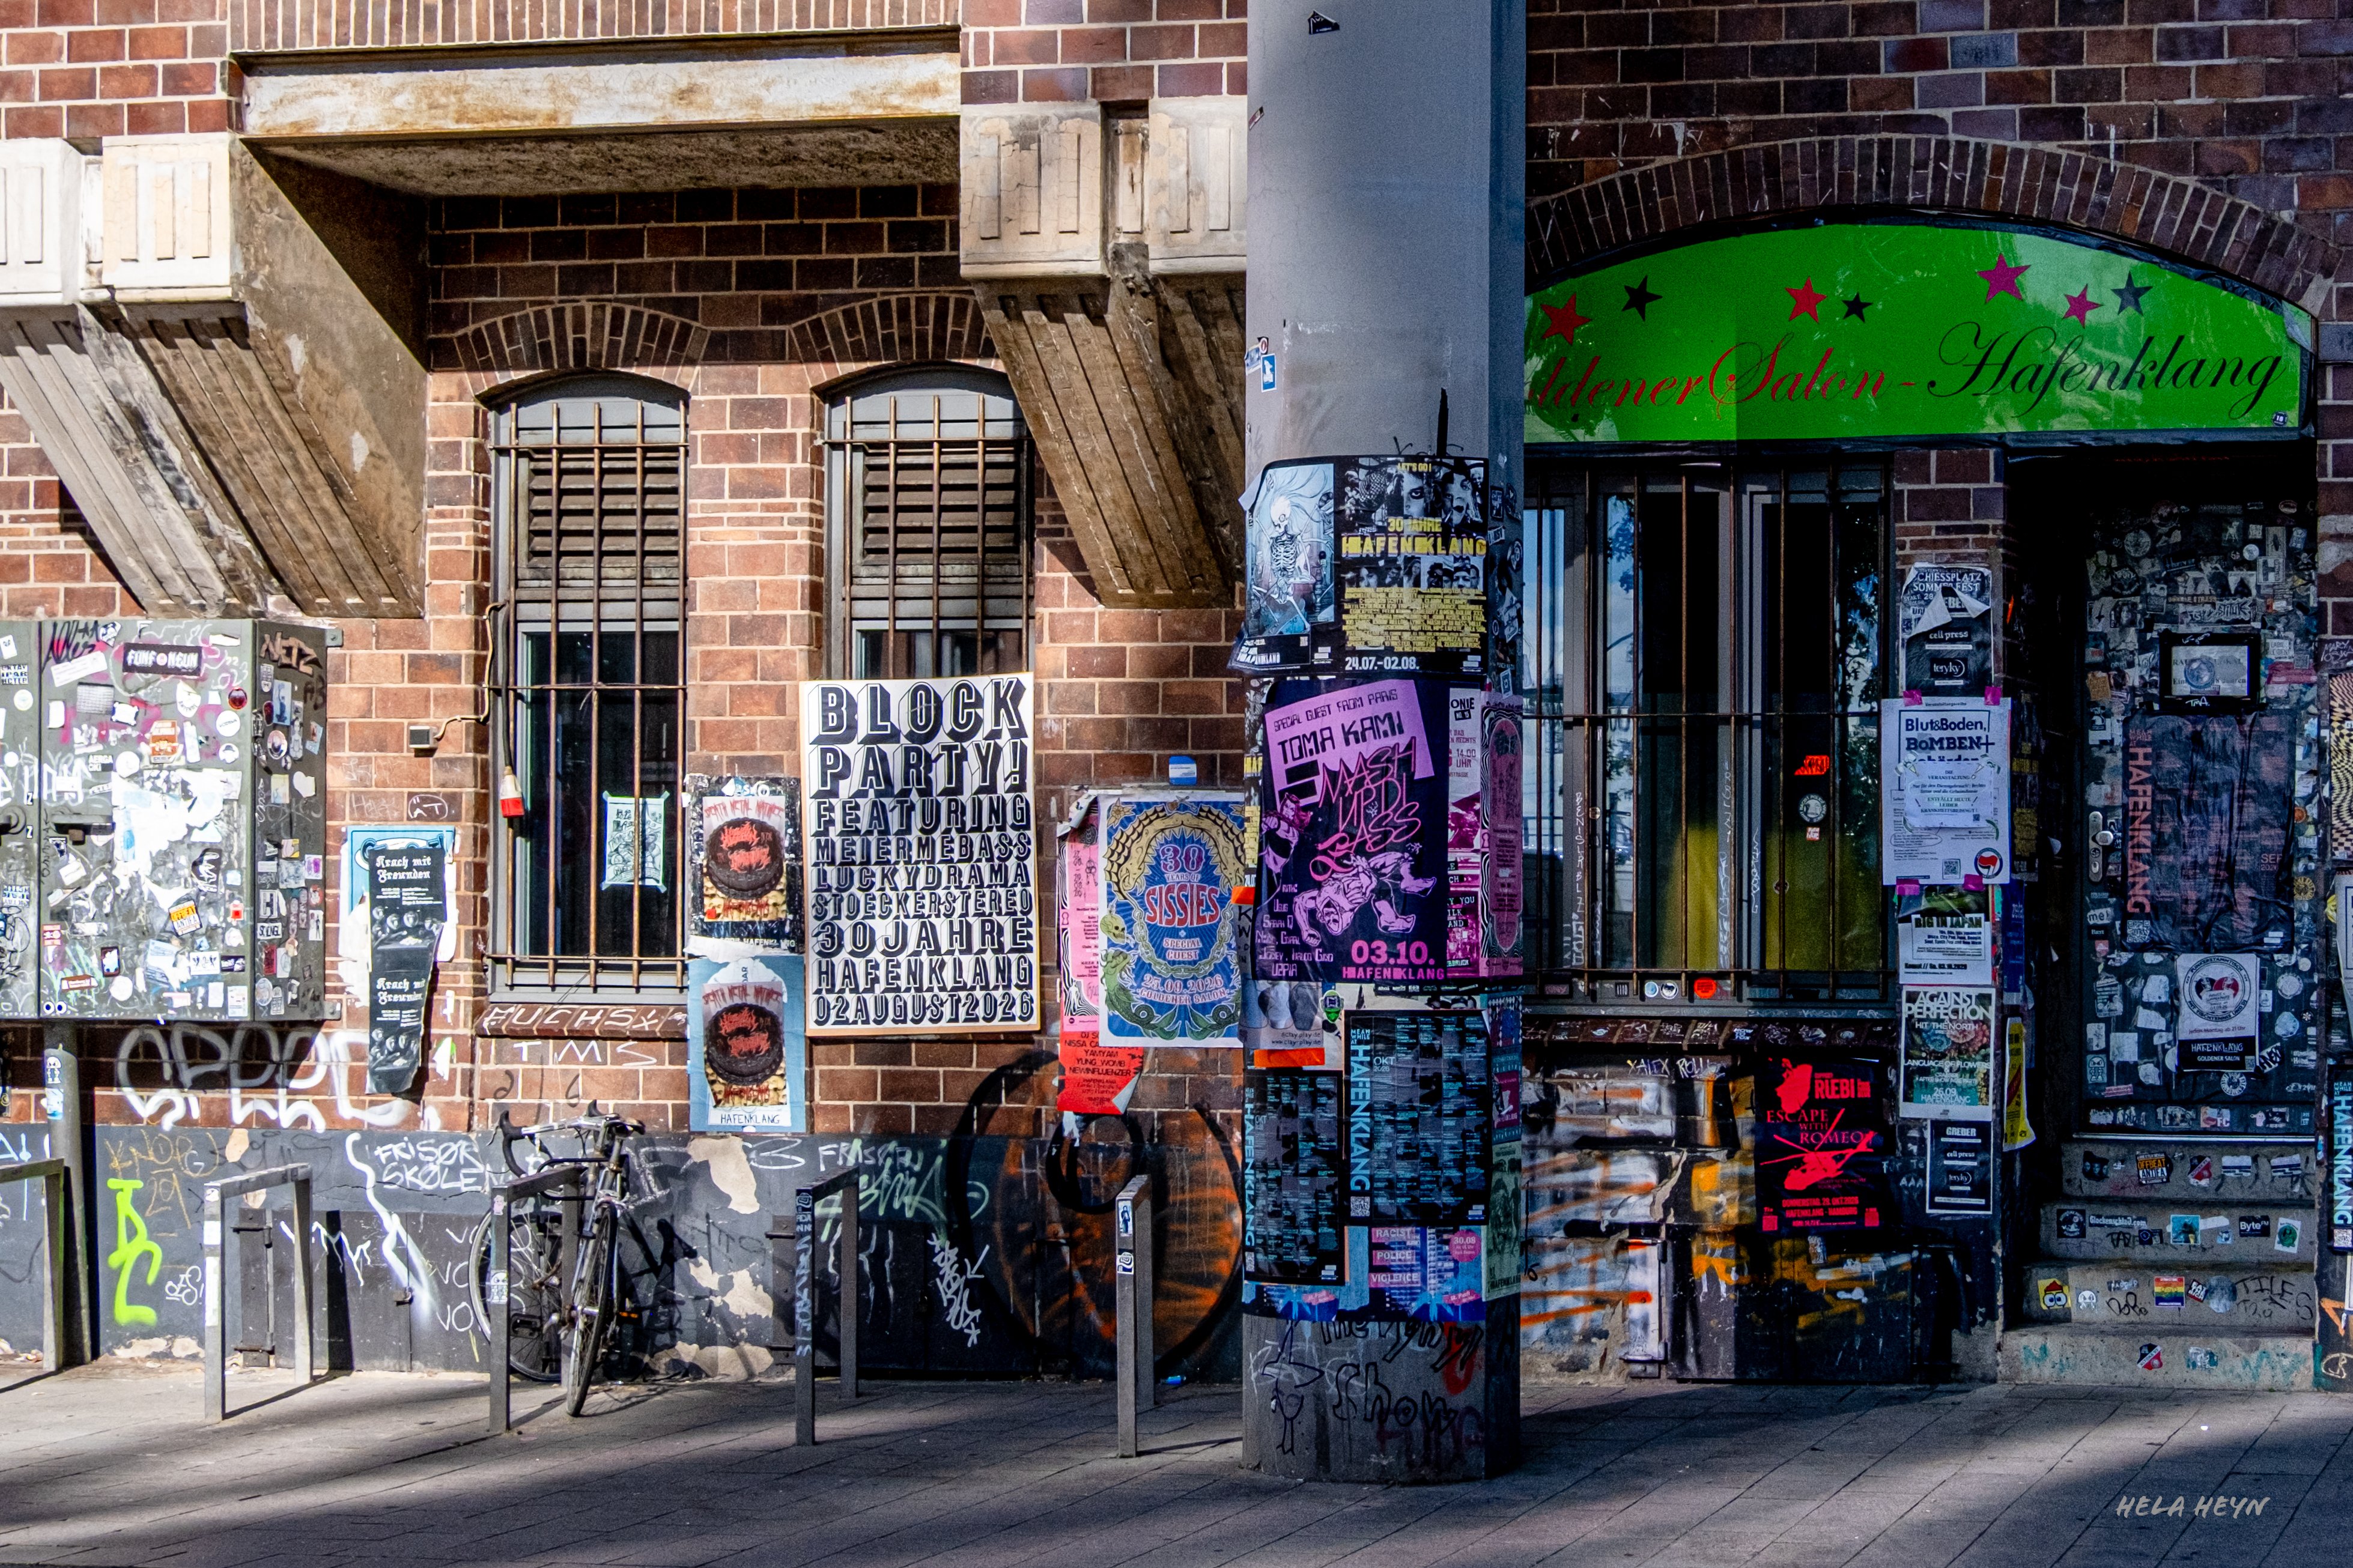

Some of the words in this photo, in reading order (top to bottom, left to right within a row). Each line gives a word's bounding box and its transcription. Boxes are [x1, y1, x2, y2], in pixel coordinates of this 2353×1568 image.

[1525, 356, 1711, 407] ldener
[1927, 321, 2286, 419] Hafenklang
[1388, 516, 1404, 531] 30
[1404, 517, 1442, 532] JAHRE
[1341, 533, 1487, 557] HAFENKLANG
[1917, 572, 1982, 582] CHIESSPLATZ
[1929, 631, 1943, 639] cell
[1946, 631, 1969, 640] press
[808, 677, 1028, 745] BLOCK
[1274, 714, 1302, 732] SPECIAL
[1305, 704, 1332, 721] GUEST
[1337, 697, 1364, 712] FROM
[1368, 689, 1398, 705] PARIS
[1278, 726, 1336, 764] TOMA
[1343, 711, 1405, 746] KAMI
[809, 739, 1028, 799] PARTY!
[1456, 758, 1472, 768] UHR
[810, 793, 1031, 837] FEATURING
[2127, 748, 2152, 913] HAFENKLANG
[811, 832, 1031, 867] MEIERMEBASS
[376, 855, 408, 869] Krach
[412, 855, 431, 866] mit
[1159, 844, 1205, 873] 30
[377, 868, 431, 883] Freunden
[1165, 873, 1189, 883] YEARS
[1190, 873, 1201, 883] OF
[1145, 882, 1220, 928] SISSIES
[1914, 916, 1934, 928] BIG
[1936, 916, 1948, 928] IN
[1949, 916, 1982, 928] JAPAN
[1163, 938, 1202, 949] SPECIAL
[1166, 949, 1200, 961] GUEST
[1351, 939, 1435, 966] 03.10.
[812, 954, 1033, 994] HAFENKLANG
[1343, 966, 1444, 981] HAFENKLANG
[376, 978, 410, 992] Krach
[1915, 991, 1979, 1007] AGAINST
[1904, 1003, 1993, 1020] PERFECTION
[1374, 1056, 1395, 1066] OKT
[1921, 1094, 1971, 1104] HAFENKLANG
[721, 1114, 780, 1125] HAFENKLANG
[1350, 1045, 1371, 1191] HAFENKLANG
[1767, 1109, 1829, 1123] ESCAPE
[2137, 1158, 2166, 1170] OFFBEAT
[2334, 1095, 2352, 1225] HAFENKLANG
[1245, 1103, 1255, 1246] HAFENKLANG
[2142, 1167, 2167, 1178] ANTIFA
[1376, 1229, 1410, 1238] RACIST
[1377, 1252, 1412, 1260] POLICE
[1371, 1273, 1418, 1282] VIOLENCE
